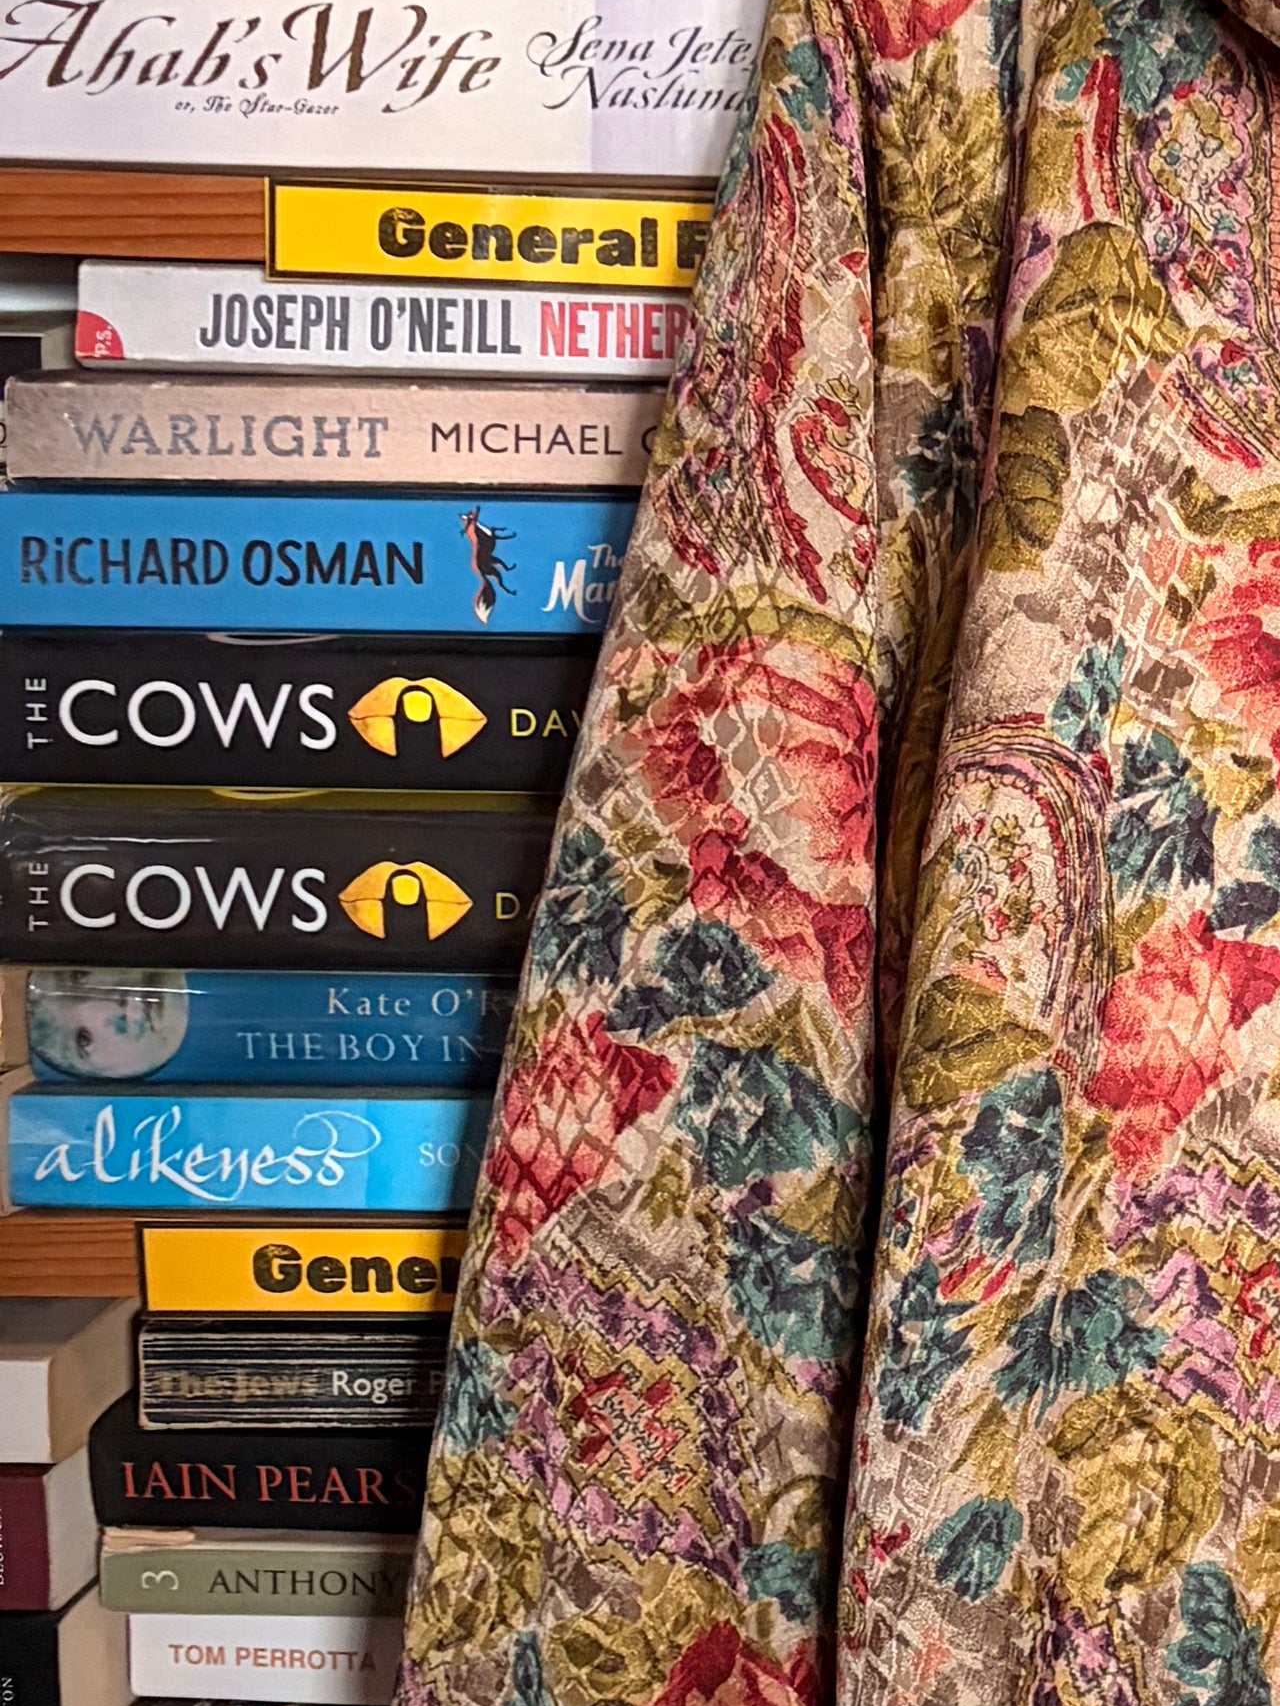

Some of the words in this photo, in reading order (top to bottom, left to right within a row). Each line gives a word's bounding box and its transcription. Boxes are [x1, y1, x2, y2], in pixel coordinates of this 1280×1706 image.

[377, 207, 658, 269] General
[200, 294, 350, 352] JOSEPH
[368, 297, 522, 356] O'NEILL
[242, 539, 424, 587] OSMAN
[25, 677, 49, 750] THE
[57, 679, 338, 751] COWS
[168, 1644, 227, 1667] TOM
[236, 1646, 376, 1672] PERROTTA
